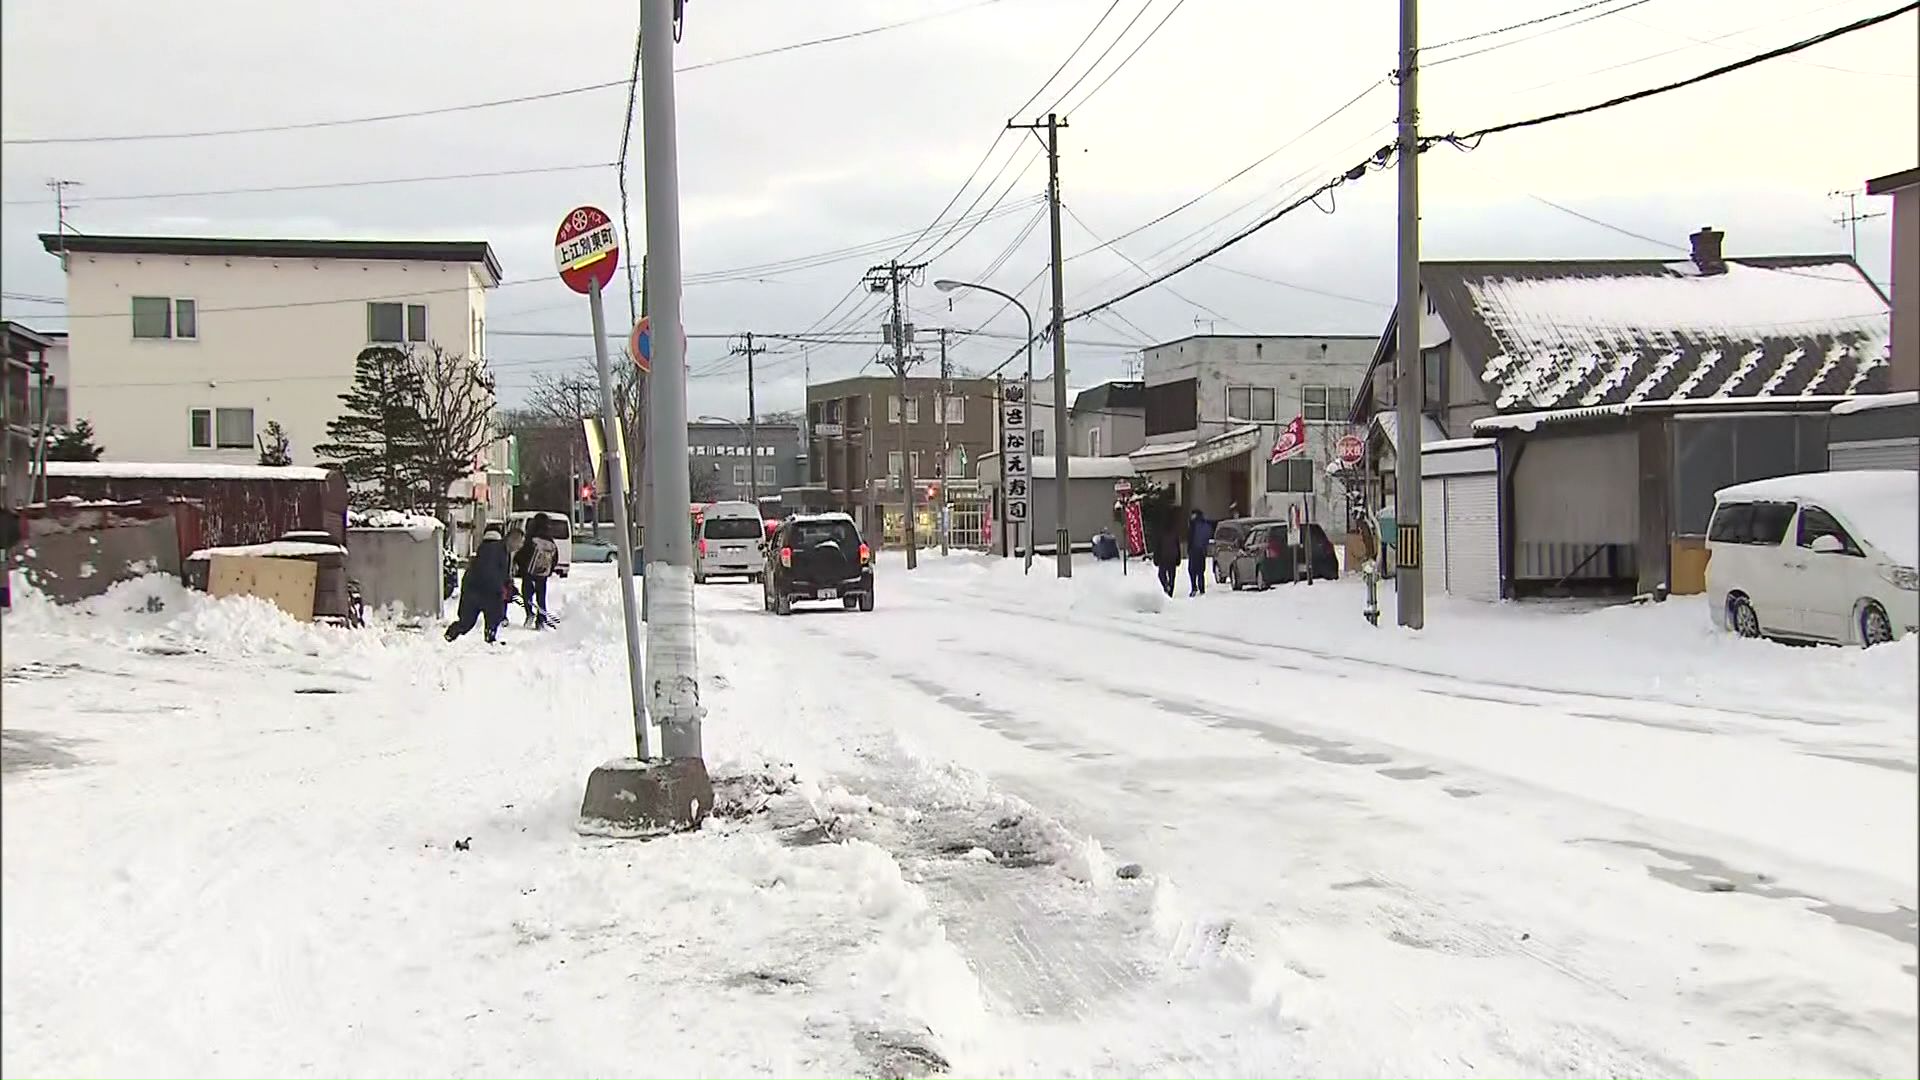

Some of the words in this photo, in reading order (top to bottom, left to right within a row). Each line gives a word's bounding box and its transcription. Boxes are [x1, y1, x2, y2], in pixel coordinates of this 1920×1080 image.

[560, 228, 613, 265] 上江別東町
[1006, 408, 1027, 519] さなえ寿司
